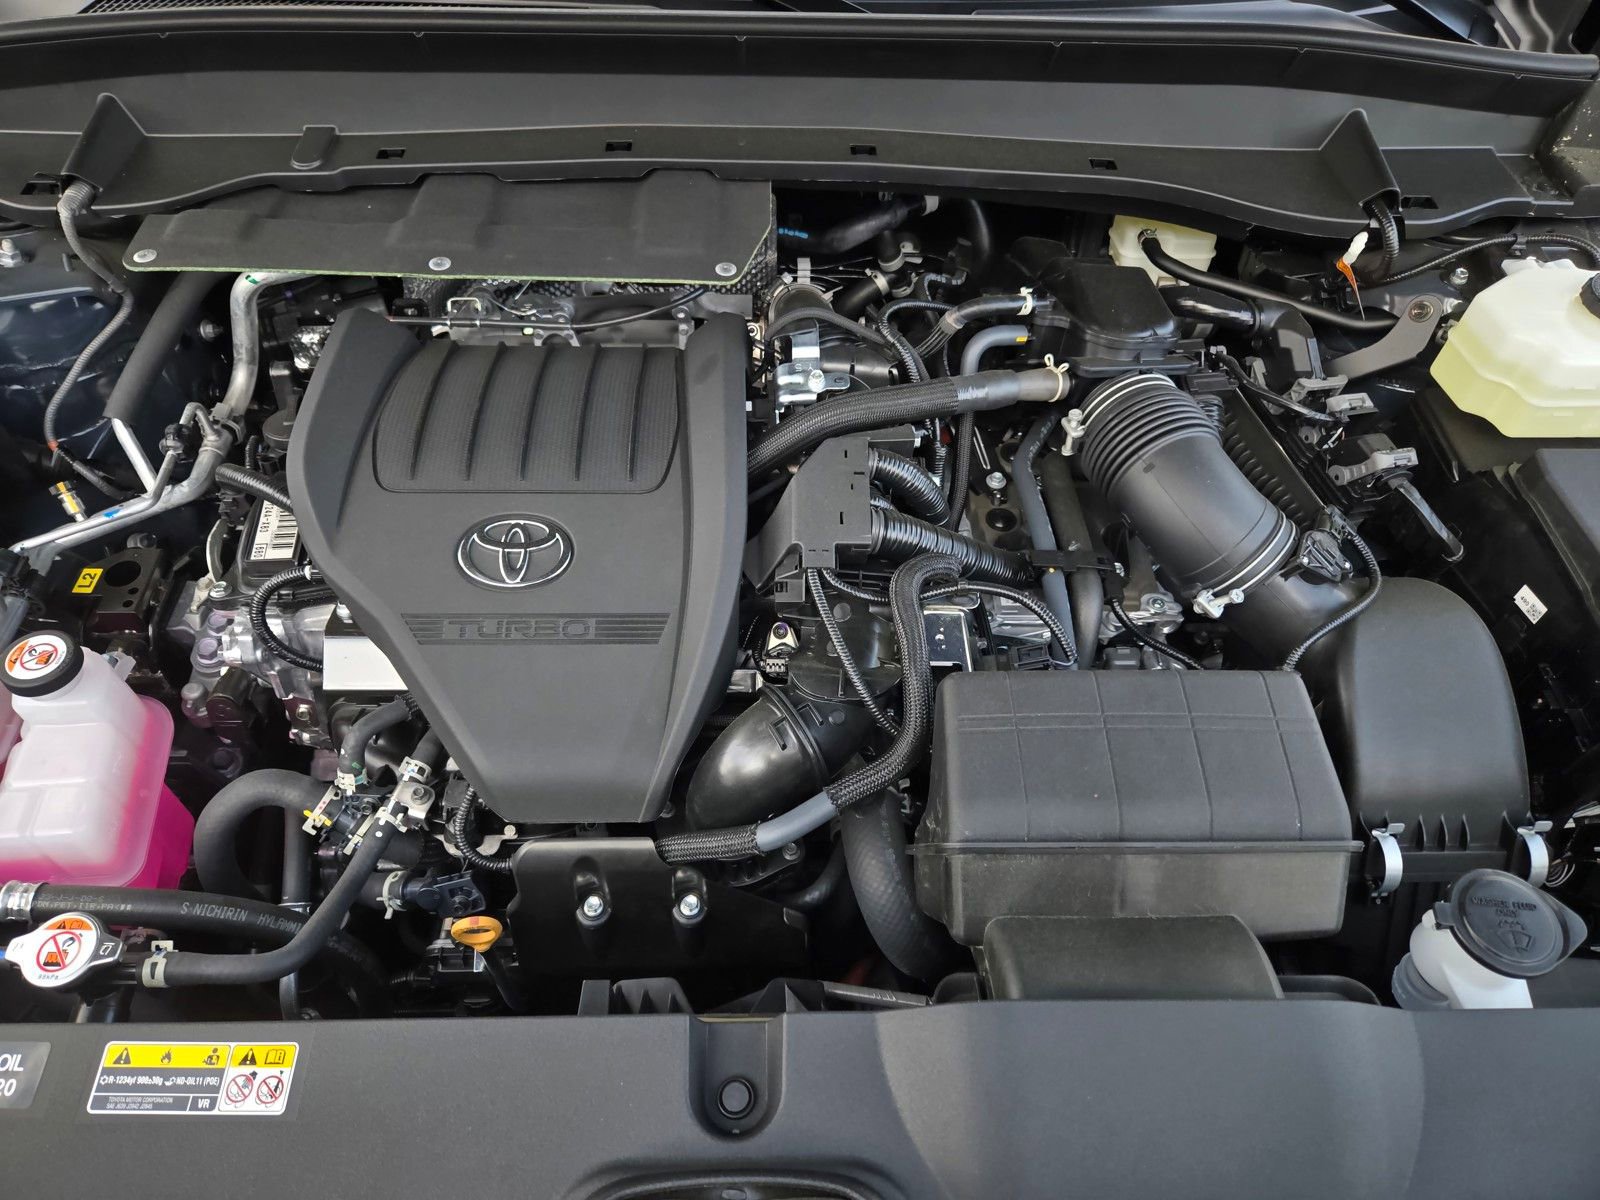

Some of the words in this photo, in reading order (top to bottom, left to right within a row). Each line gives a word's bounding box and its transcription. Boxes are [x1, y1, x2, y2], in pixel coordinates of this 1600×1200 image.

[77, 572, 97, 588] L2
[447, 619, 591, 639] TURBO
[0, 1054, 24, 1071] OIL
[197, 1099, 211, 1109] VR
